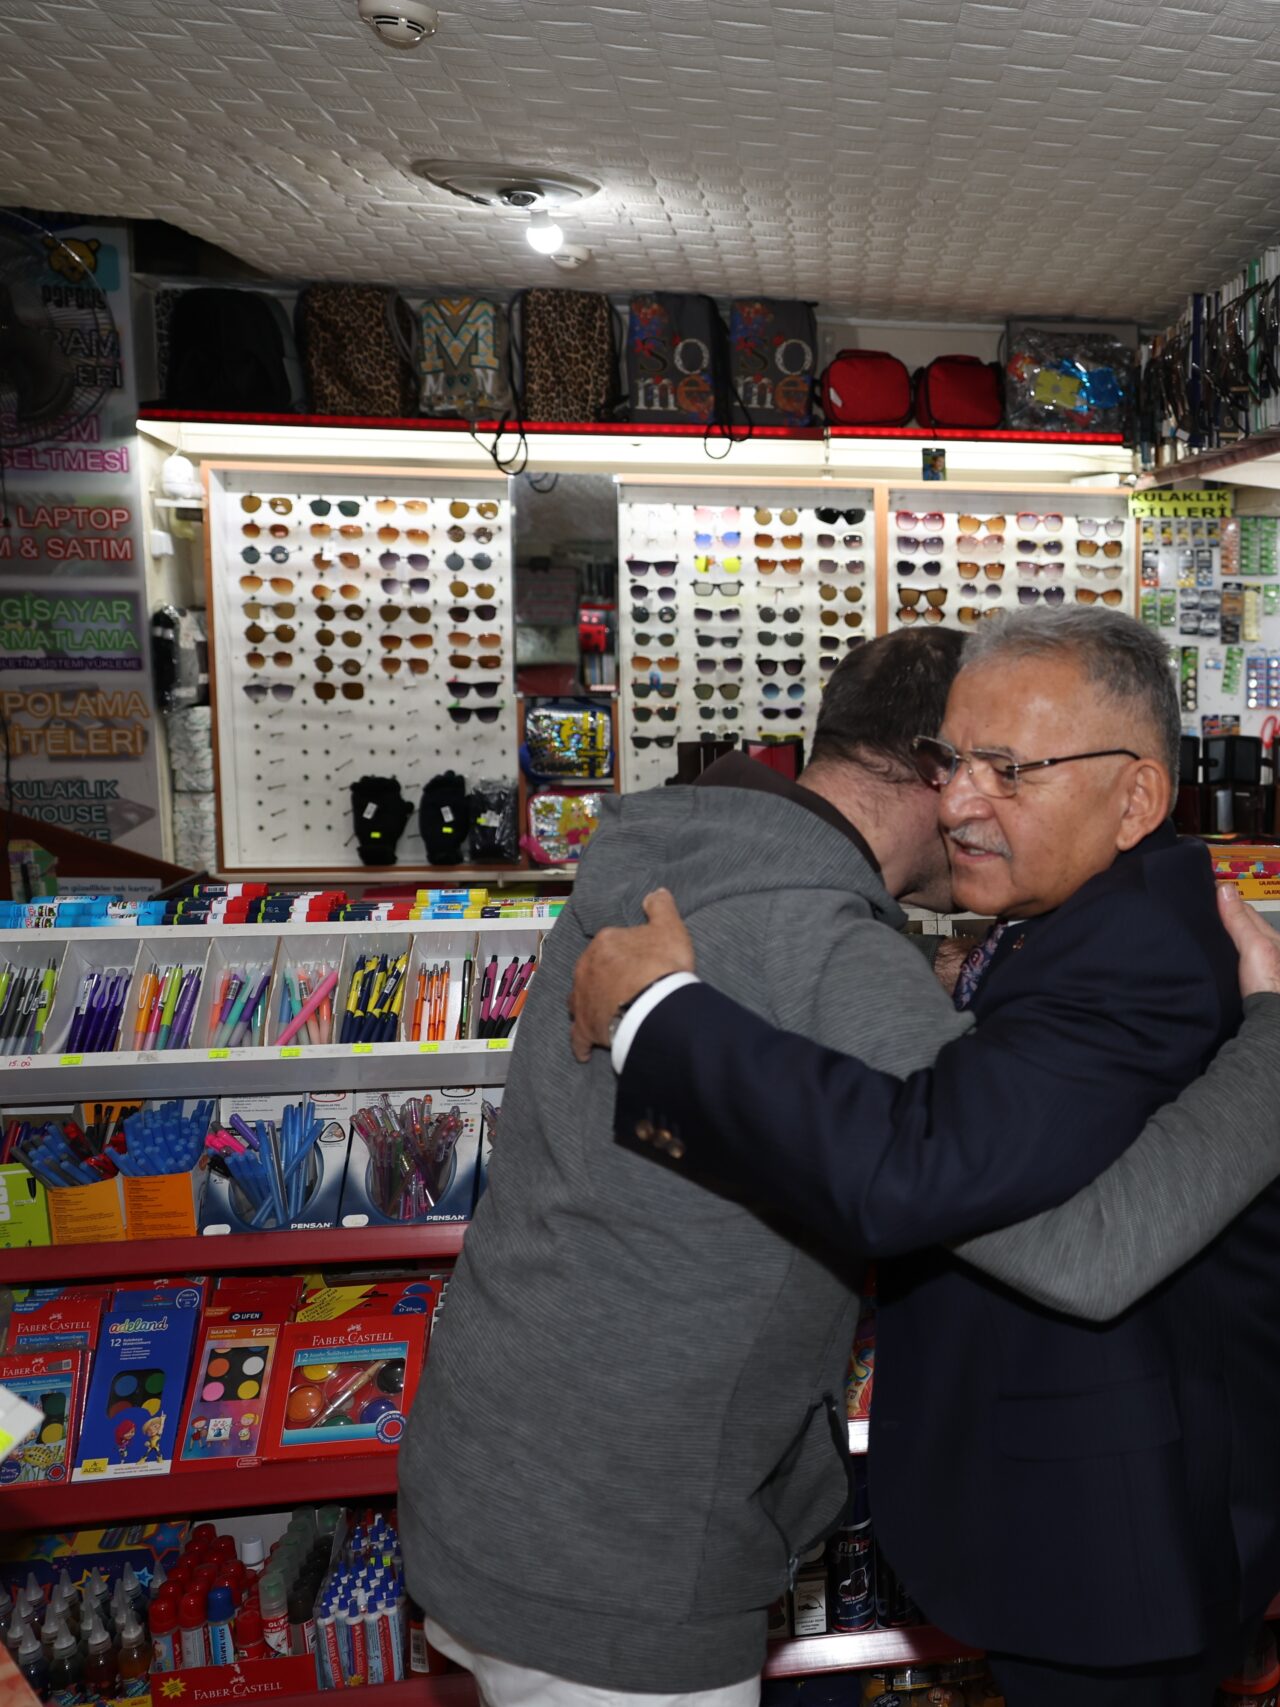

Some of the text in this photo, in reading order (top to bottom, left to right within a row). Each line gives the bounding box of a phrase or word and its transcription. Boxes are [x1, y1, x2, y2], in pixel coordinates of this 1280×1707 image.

[1131, 491, 1229, 502] KULAKLIK
[16, 505, 131, 530] LAPTOP
[1132, 504, 1228, 518] PİLLERİ
[19, 536, 39, 560] &
[46, 537, 133, 561] SATIM
[10, 778, 120, 800] KULAKLIK
[20, 803, 107, 824] MOUSE
[290, 1222, 333, 1230] PENSAN
[427, 1214, 468, 1222] PENSAN
[16, 1320, 92, 1334] FABER-CASTELL
[108, 1315, 169, 1334] adeland
[110, 1338, 122, 1348] 12
[312, 1331, 395, 1347] FABER-CASTELL
[193, 1681, 284, 1701] FABER-CASTELL
